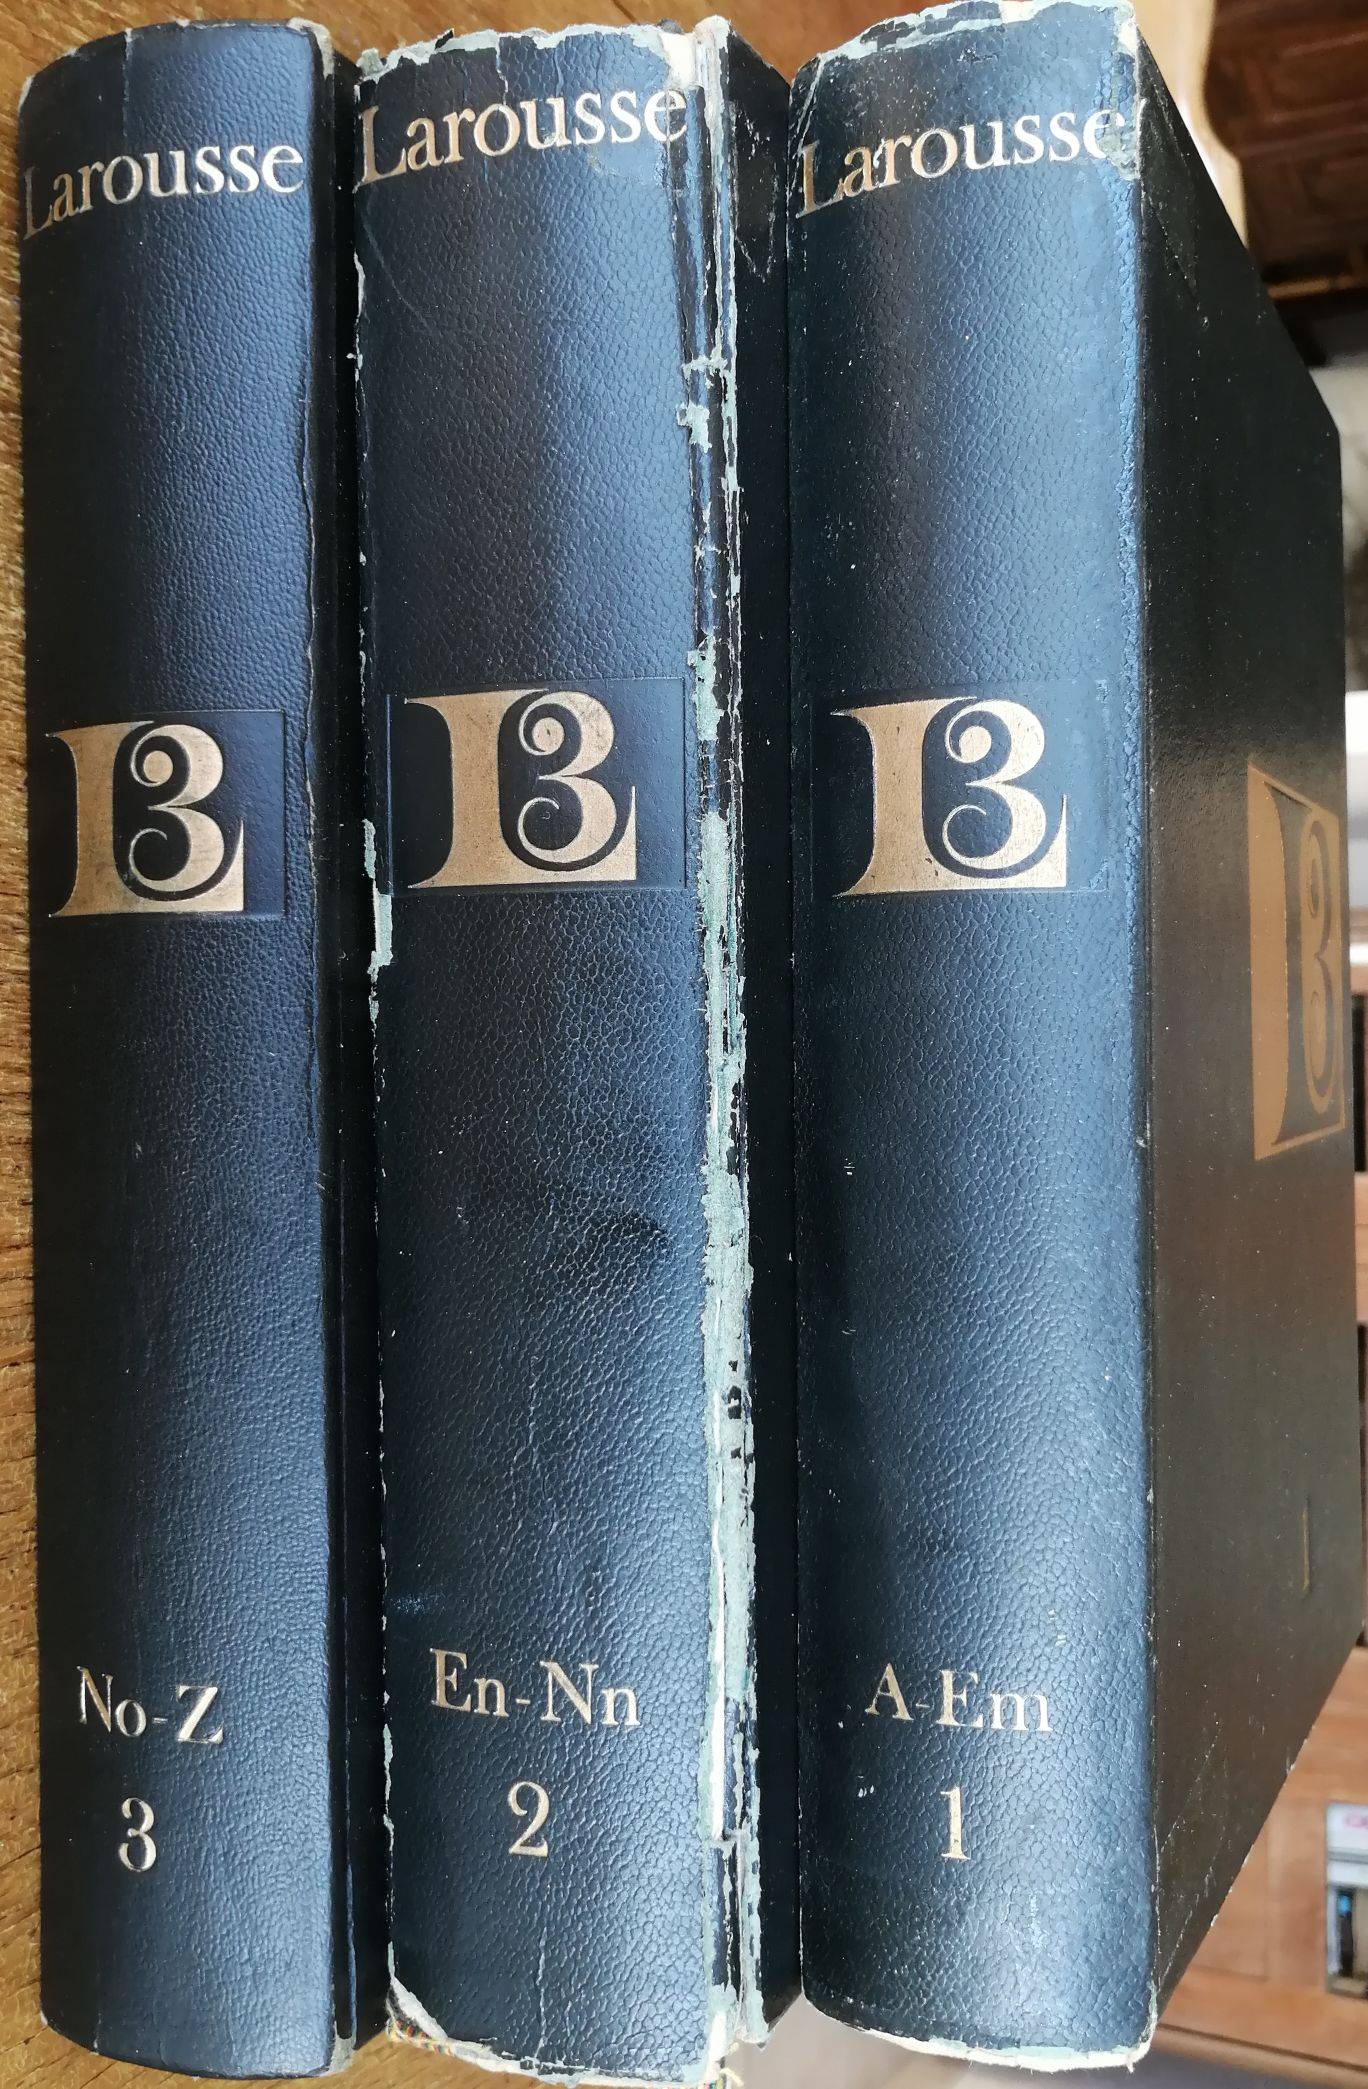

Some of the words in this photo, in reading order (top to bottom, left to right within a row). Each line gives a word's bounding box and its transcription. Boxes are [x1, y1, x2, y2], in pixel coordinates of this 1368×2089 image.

[354, 86, 690, 194] Larousse
[20, 142, 306, 243] Larousse
[76, 1665, 225, 1745] No-Z
[429, 1647, 642, 1729] En-Nn
[864, 1662, 1054, 1733] A-Em
[117, 1797, 158, 1874] 3
[507, 1780, 551, 1858] 2
[940, 1786, 972, 1861] 1
